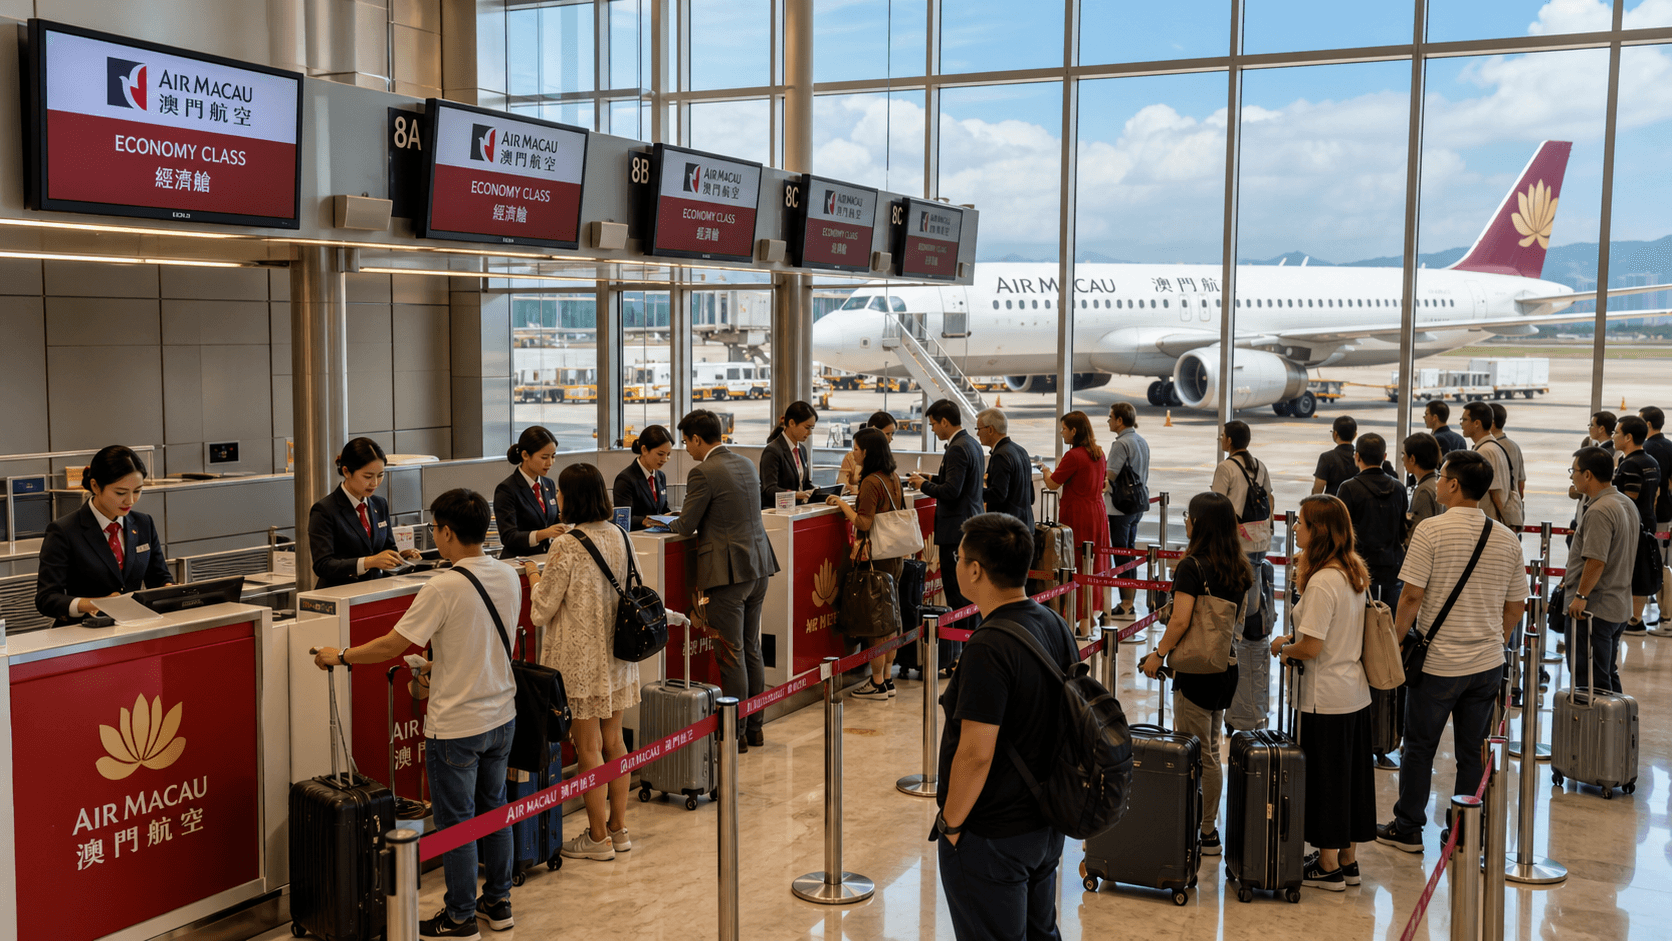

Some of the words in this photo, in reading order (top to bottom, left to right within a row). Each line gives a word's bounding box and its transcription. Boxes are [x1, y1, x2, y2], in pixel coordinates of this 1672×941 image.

[159, 69, 191, 93] AIR
[193, 75, 253, 103] MACAU
[159, 93, 252, 127] 澳門航空
[394, 116, 422, 151] 8A
[501, 130, 521, 148] AIR
[521, 134, 559, 154] MACAU
[115, 134, 198, 160] ECONOMY
[201, 146, 247, 166] CLASS
[500, 149, 557, 172] 澳門航空
[155, 166, 212, 193] 經濟艙
[631, 157, 650, 184] 8B
[471, 180, 522, 200] ECONOMY
[523, 187, 551, 203] CLASS
[785, 185, 800, 208] 8C
[682, 208, 716, 221] ECONOMY
[716, 213, 736, 224] CLASS
[892, 205, 904, 226] 8C
[996, 277, 1036, 294] AIR
[1038, 277, 1117, 294] MCAU
[1151, 277, 1222, 293] 澳門航
[390, 719, 420, 744] AIR
[72, 803, 119, 836] AIR
[124, 775, 208, 820] MACAU
[505, 804, 524, 823] AIR
[76, 807, 204, 871] 澳門航空
